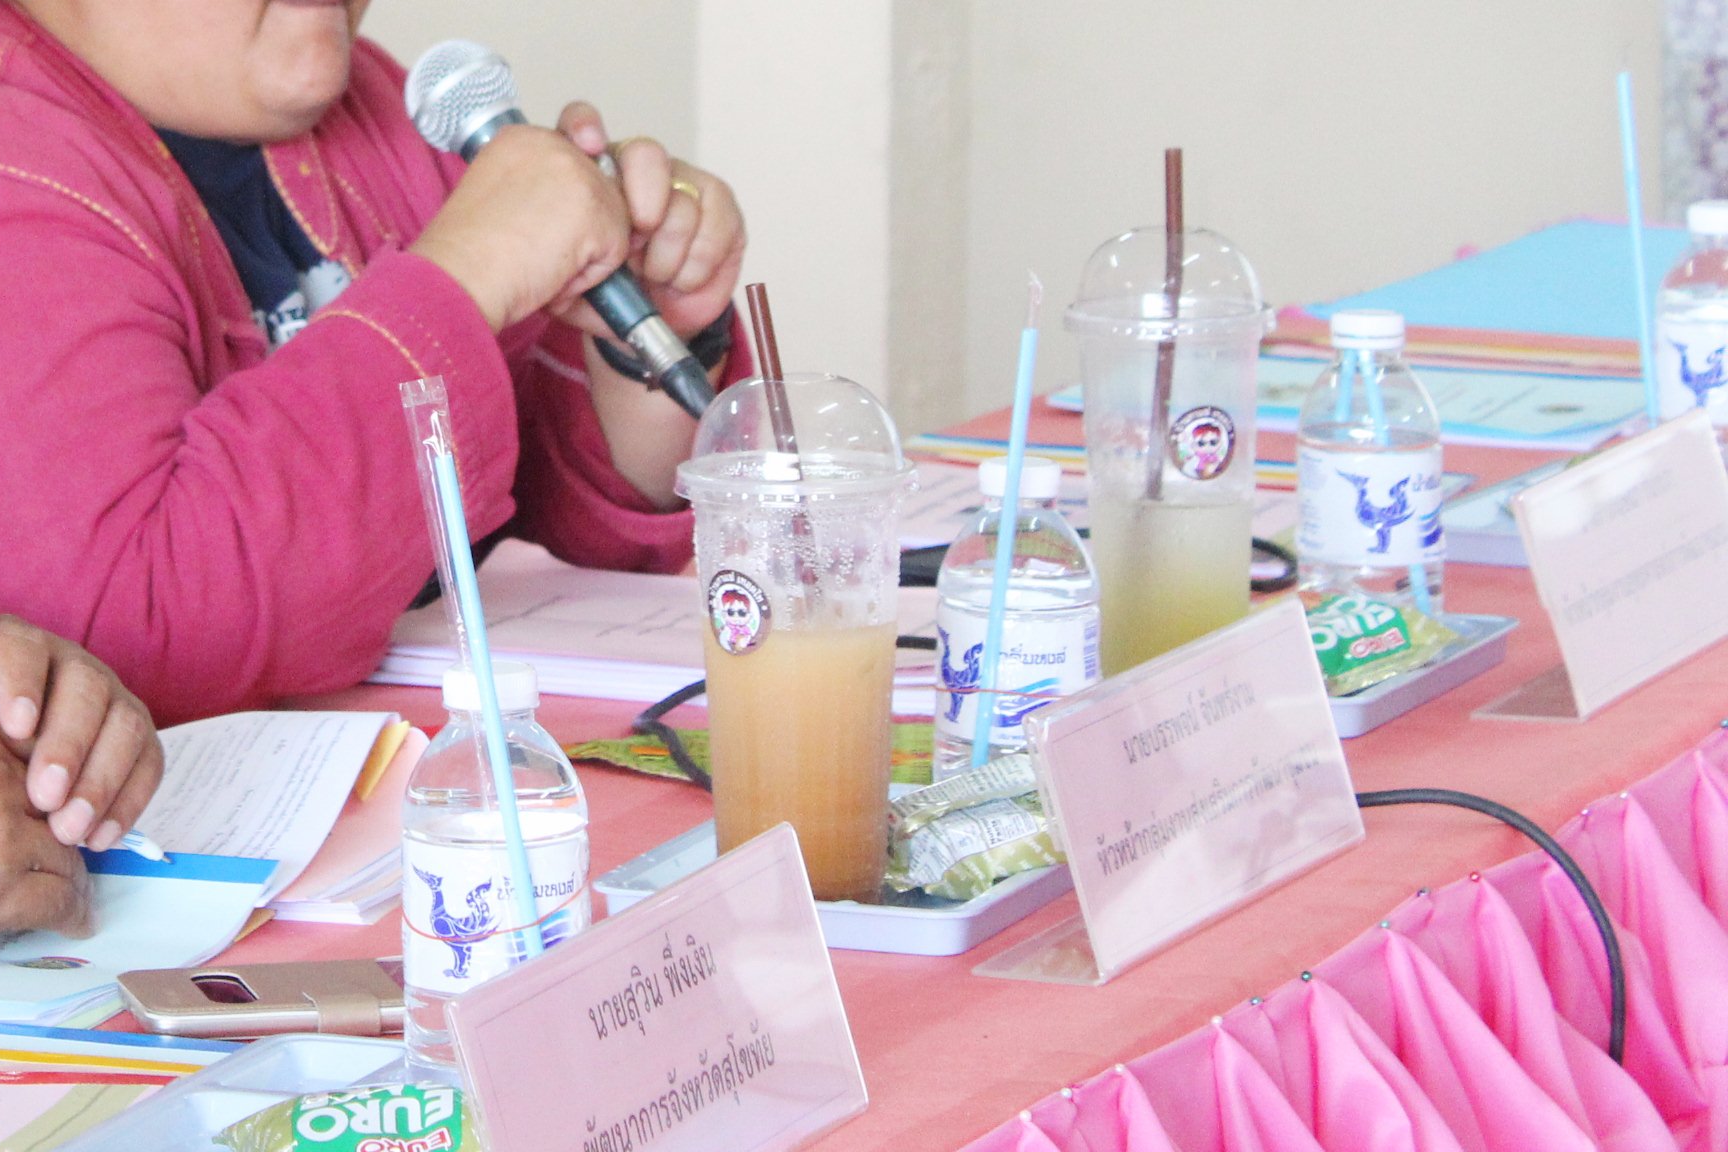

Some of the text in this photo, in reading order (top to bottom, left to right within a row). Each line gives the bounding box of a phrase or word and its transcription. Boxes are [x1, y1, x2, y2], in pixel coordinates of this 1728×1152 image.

[588, 961, 664, 1041] นายสุวิน
[295, 1088, 455, 1143] EURO
